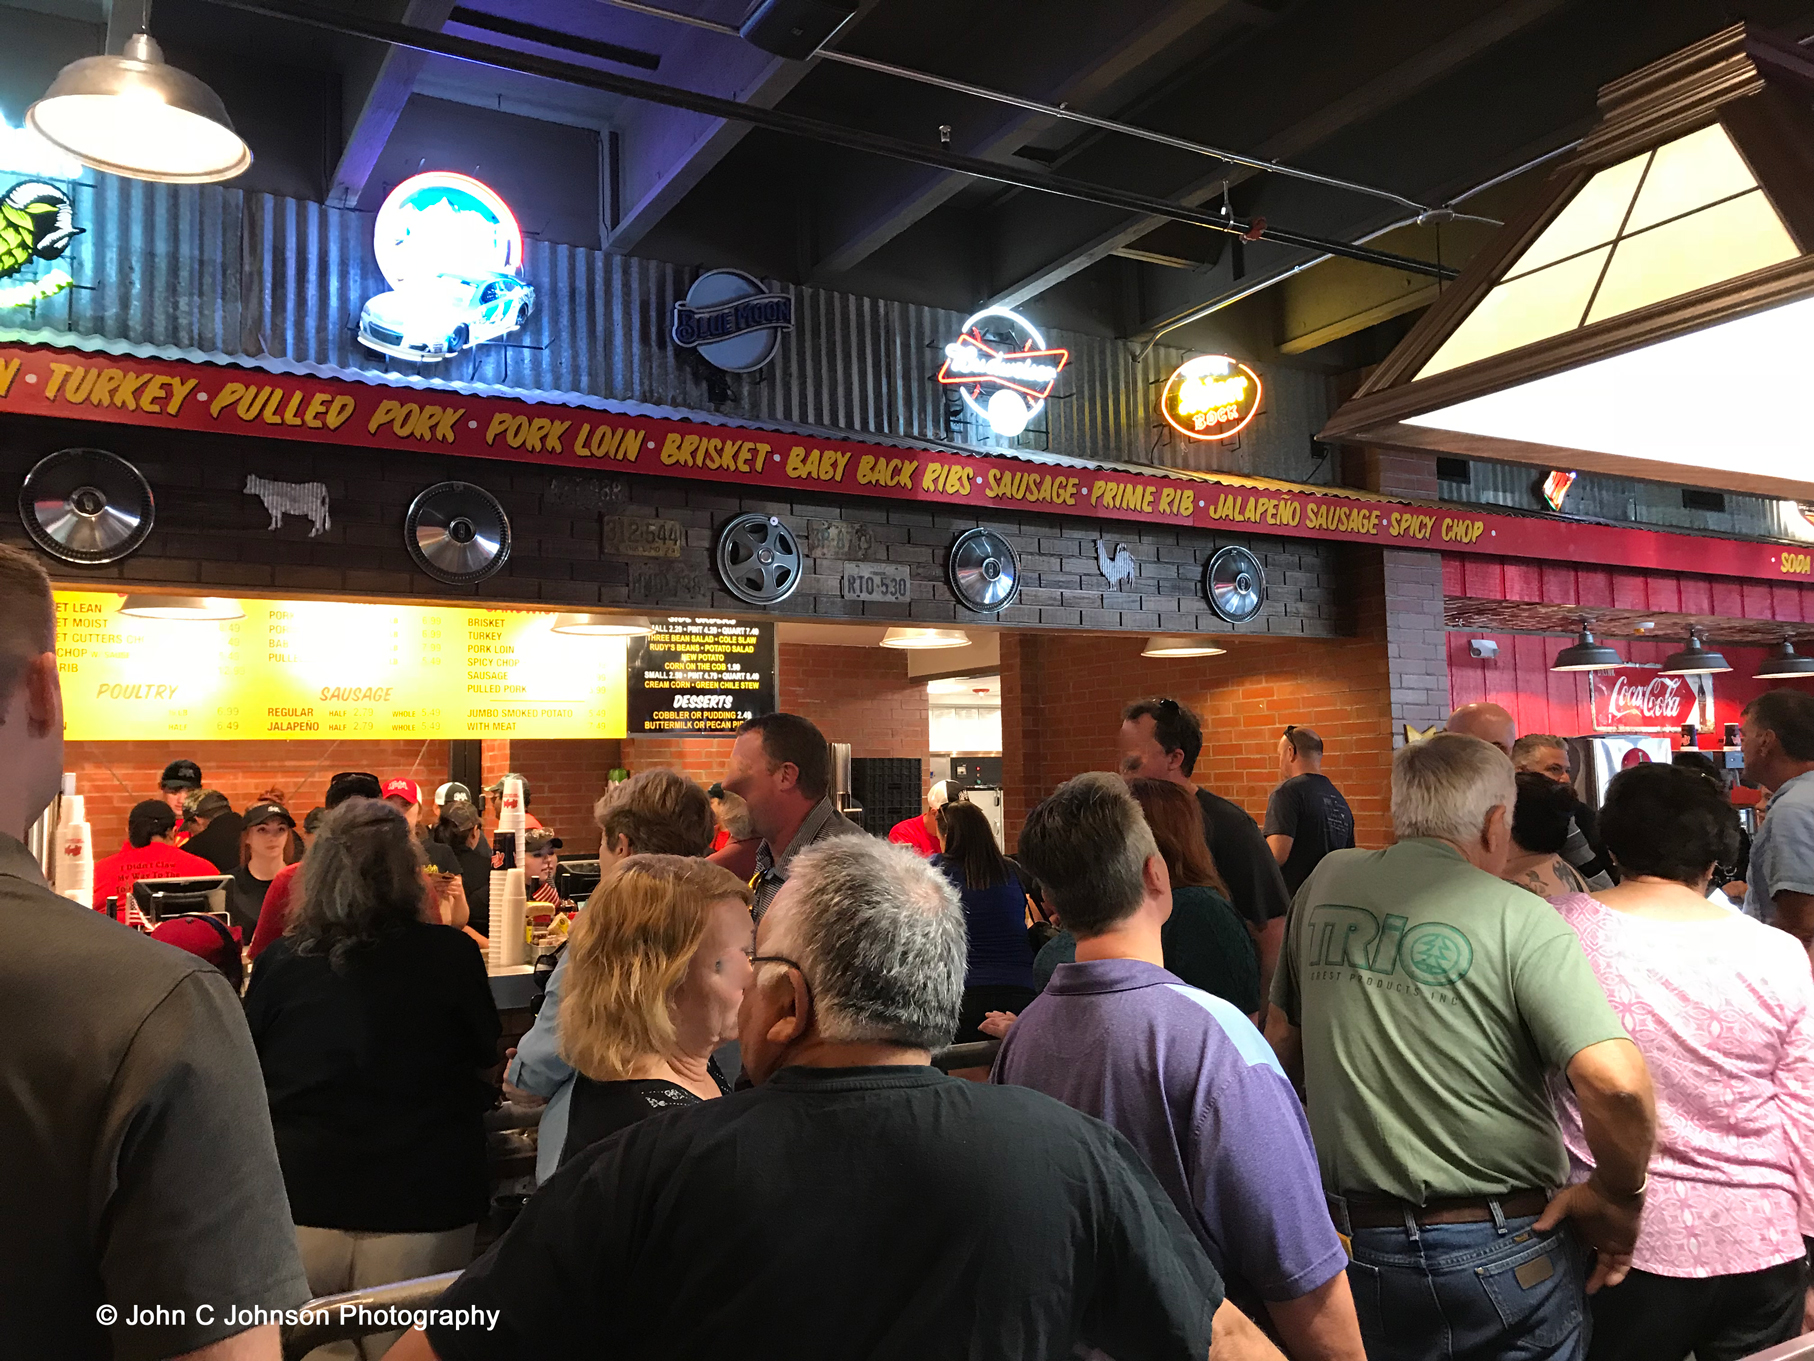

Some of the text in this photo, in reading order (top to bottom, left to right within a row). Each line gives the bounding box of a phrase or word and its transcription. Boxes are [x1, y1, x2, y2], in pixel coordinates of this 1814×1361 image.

[677, 299, 790, 342] BLUE MOON
[1192, 404, 1239, 431] BOCK
[45, 362, 199, 416] TURKEY
[209, 382, 356, 431] PULLED
[368, 399, 466, 444] PORK
[486, 412, 573, 455] PORK
[574, 423, 646, 463] LOIN
[660, 432, 772, 474] BRISKET
[785, 446, 853, 483] BABY
[856, 454, 919, 490] BACK
[922, 462, 975, 496] RIBS
[985, 468, 1079, 505] SAUSAGE
[1089, 480, 1157, 514] PRIME
[1159, 487, 1195, 518] RIB
[1209, 494, 1301, 527] JALAPEÑO
[1305, 502, 1380, 535] SAUSAGE
[1389, 512, 1437, 541] SPICY
[1441, 518, 1484, 544] CHOP
[1780, 552, 1811, 574] SODA
[73, 603, 102, 613] LEAN
[72, 618, 108, 628] MOIST
[467, 618, 505, 627] BRISKET
[687, 626, 703, 634] PINT
[722, 627, 745, 635] QUART
[72, 633, 122, 644] CUTTERS
[468, 631, 502, 641] TURKEY
[648, 633, 757, 645] THREE BEAN SALAD COLE SLAW
[56, 648, 87, 658] CHOP
[467, 644, 515, 654] PORK LOIN
[650, 643, 754, 654] RUDY'S BEANS POTATO SALAD
[467, 657, 520, 667] SPICY CHOP
[681, 653, 725, 662] NEW POTATO
[59, 663, 78, 673] RIB
[664, 662, 685, 670] CORN
[686, 662, 696, 670] ON
[697, 662, 711, 670] THE
[711, 663, 726, 671] COB
[467, 671, 508, 680] SAUSAGE
[644, 671, 668, 679] SMALL
[688, 671, 703, 680] PINT
[722, 672, 745, 680] QUART
[467, 684, 527, 693] PULLED PORK
[644, 681, 760, 690] CREAM CORN GREEN CHILE STEW
[96, 683, 179, 700] POULTRY
[319, 686, 394, 702] SAUSAGE
[673, 694, 734, 709] DESSERTS
[267, 708, 314, 717] REGULAR
[353, 708, 374, 717] 2.79
[421, 708, 441, 717] 5.49
[467, 709, 499, 718] JUMBO
[501, 709, 538, 718] SMOKED
[541, 709, 573, 718] POTATO
[653, 711, 690, 719] COBBLER
[691, 711, 702, 719] OR
[703, 711, 736, 720] PUDDING
[217, 721, 239, 731] 6.49
[267, 719, 319, 731] JALAPEÑO
[353, 722, 374, 731] 2.79
[421, 722, 441, 731] 5.49
[467, 722, 490, 731] WITH
[492, 722, 516, 731] MEAT
[644, 720, 693, 730] BUTTERMILK
[693, 721, 705, 729] OR
[706, 720, 731, 729] PECAN
[1350, 973, 1420, 997] PRODUCTS
[1431, 991, 1459, 1006] INC
